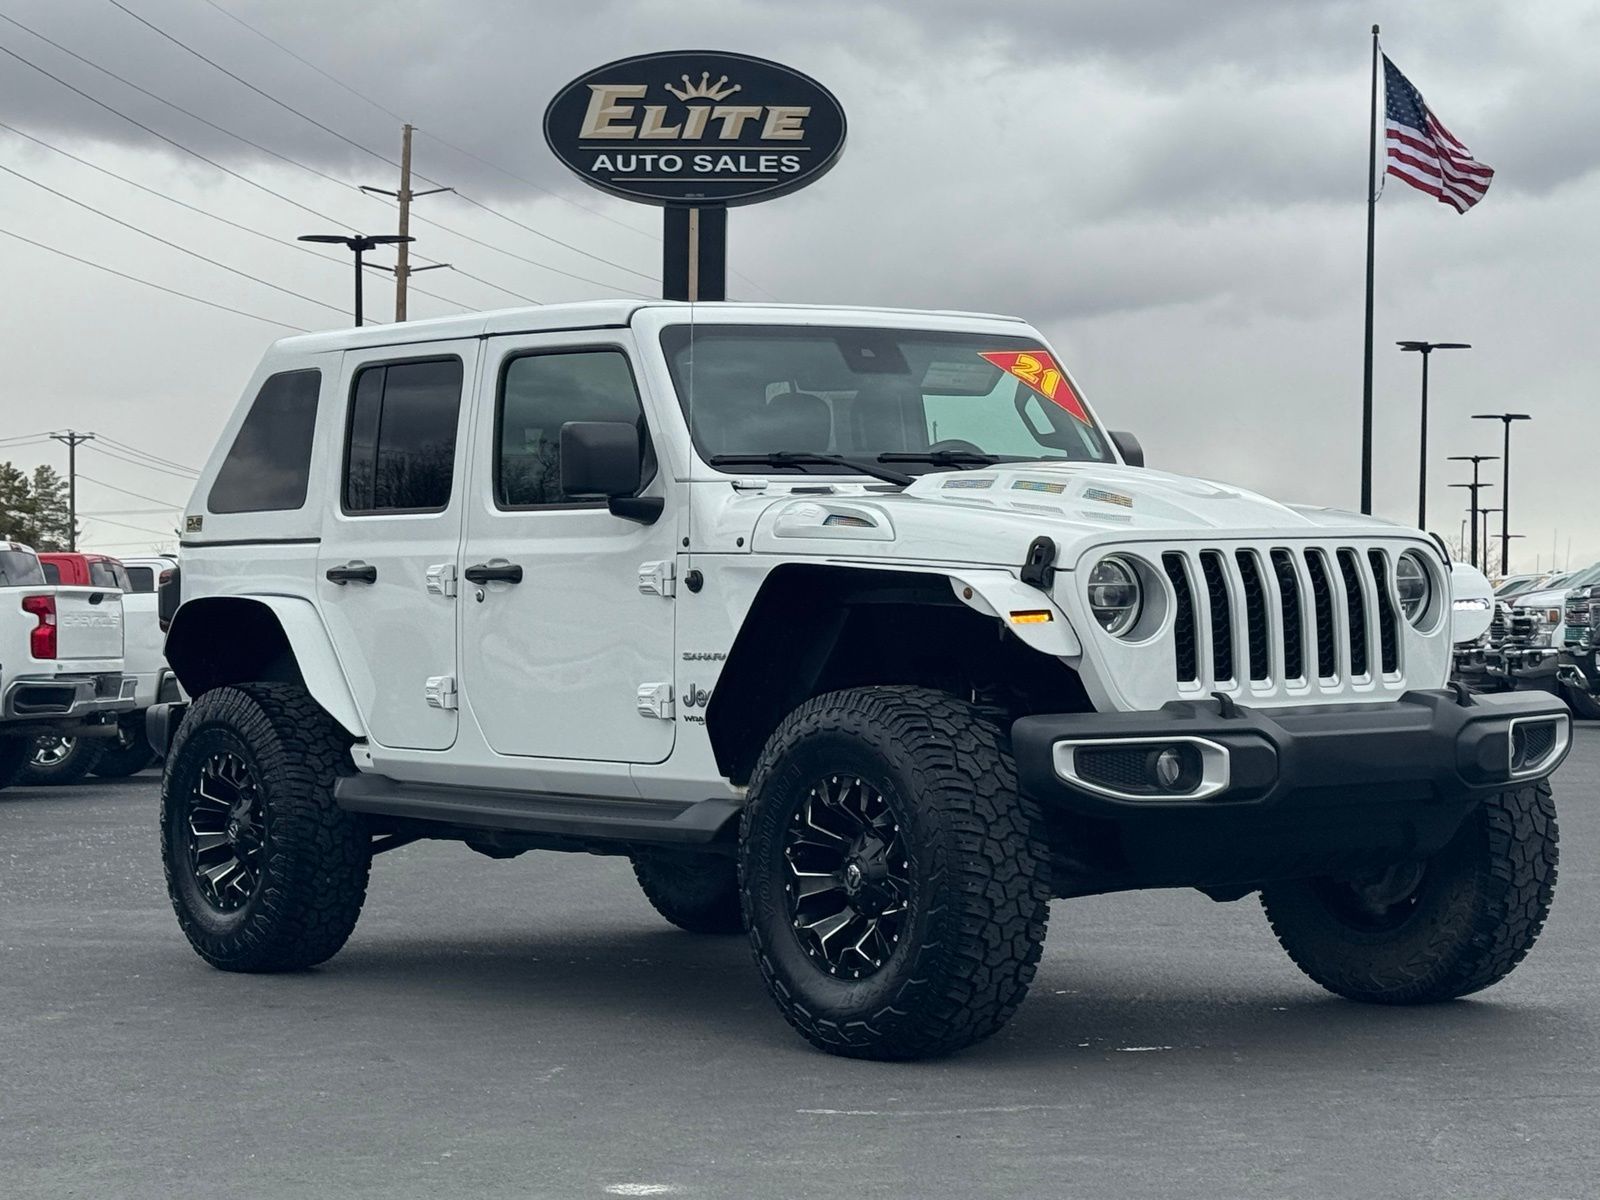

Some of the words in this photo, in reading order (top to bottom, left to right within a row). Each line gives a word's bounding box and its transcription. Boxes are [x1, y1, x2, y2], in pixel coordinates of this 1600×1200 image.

[578, 84, 812, 141] ELITE
[591, 154, 683, 173] AUTO
[693, 154, 801, 173] SALES
[1011, 353, 1061, 399] 21
[682, 683, 712, 708] Je
